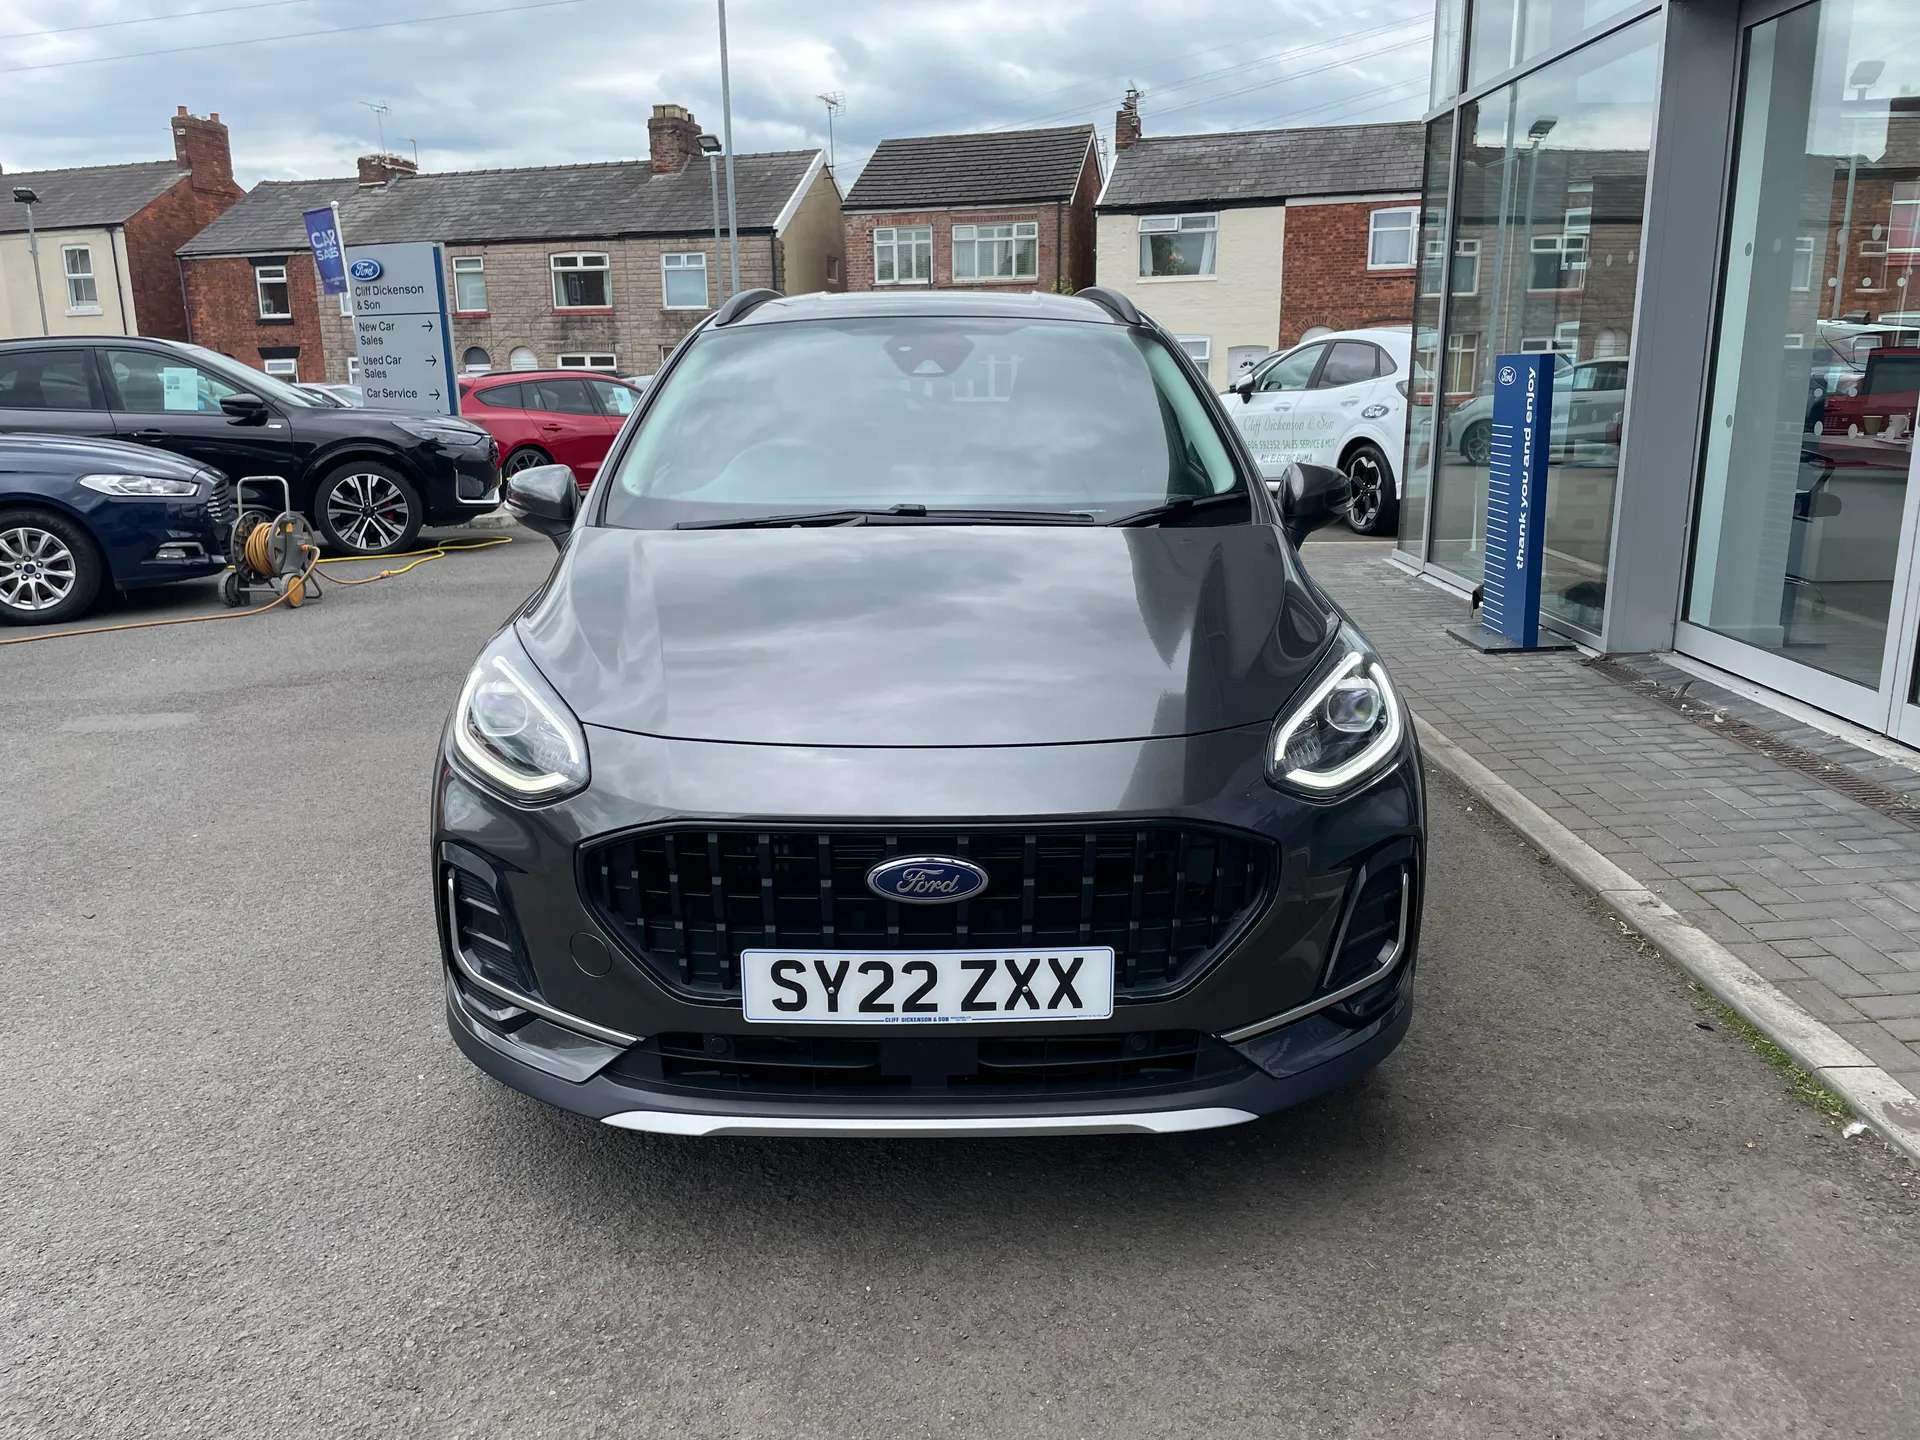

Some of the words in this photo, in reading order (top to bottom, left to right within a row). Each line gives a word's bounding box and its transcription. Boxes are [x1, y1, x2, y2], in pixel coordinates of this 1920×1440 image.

[311, 229, 337, 249] CAR
[354, 262, 374, 277] Ford
[355, 286, 372, 297] Cliff
[372, 284, 424, 296] Dickenson
[356, 301, 362, 310] &
[363, 300, 381, 310] Son
[359, 322, 377, 332] New
[378, 321, 394, 331] Car
[360, 335, 383, 345] Sales
[362, 355, 384, 366] Used
[385, 355, 402, 365] Car
[364, 369, 387, 379] Sales
[366, 388, 382, 398] Car
[382, 388, 418, 398] Service
[1525, 367, 1536, 424] enjoy
[1263, 415, 1305, 431] Dickenson
[1523, 427, 1531, 468] and
[1519, 472, 1529, 507] you
[1516, 511, 1526, 570] thank
[896, 868, 959, 894] Ford
[770, 959, 939, 1013] SY22
[959, 957, 1084, 1012] ZXX
